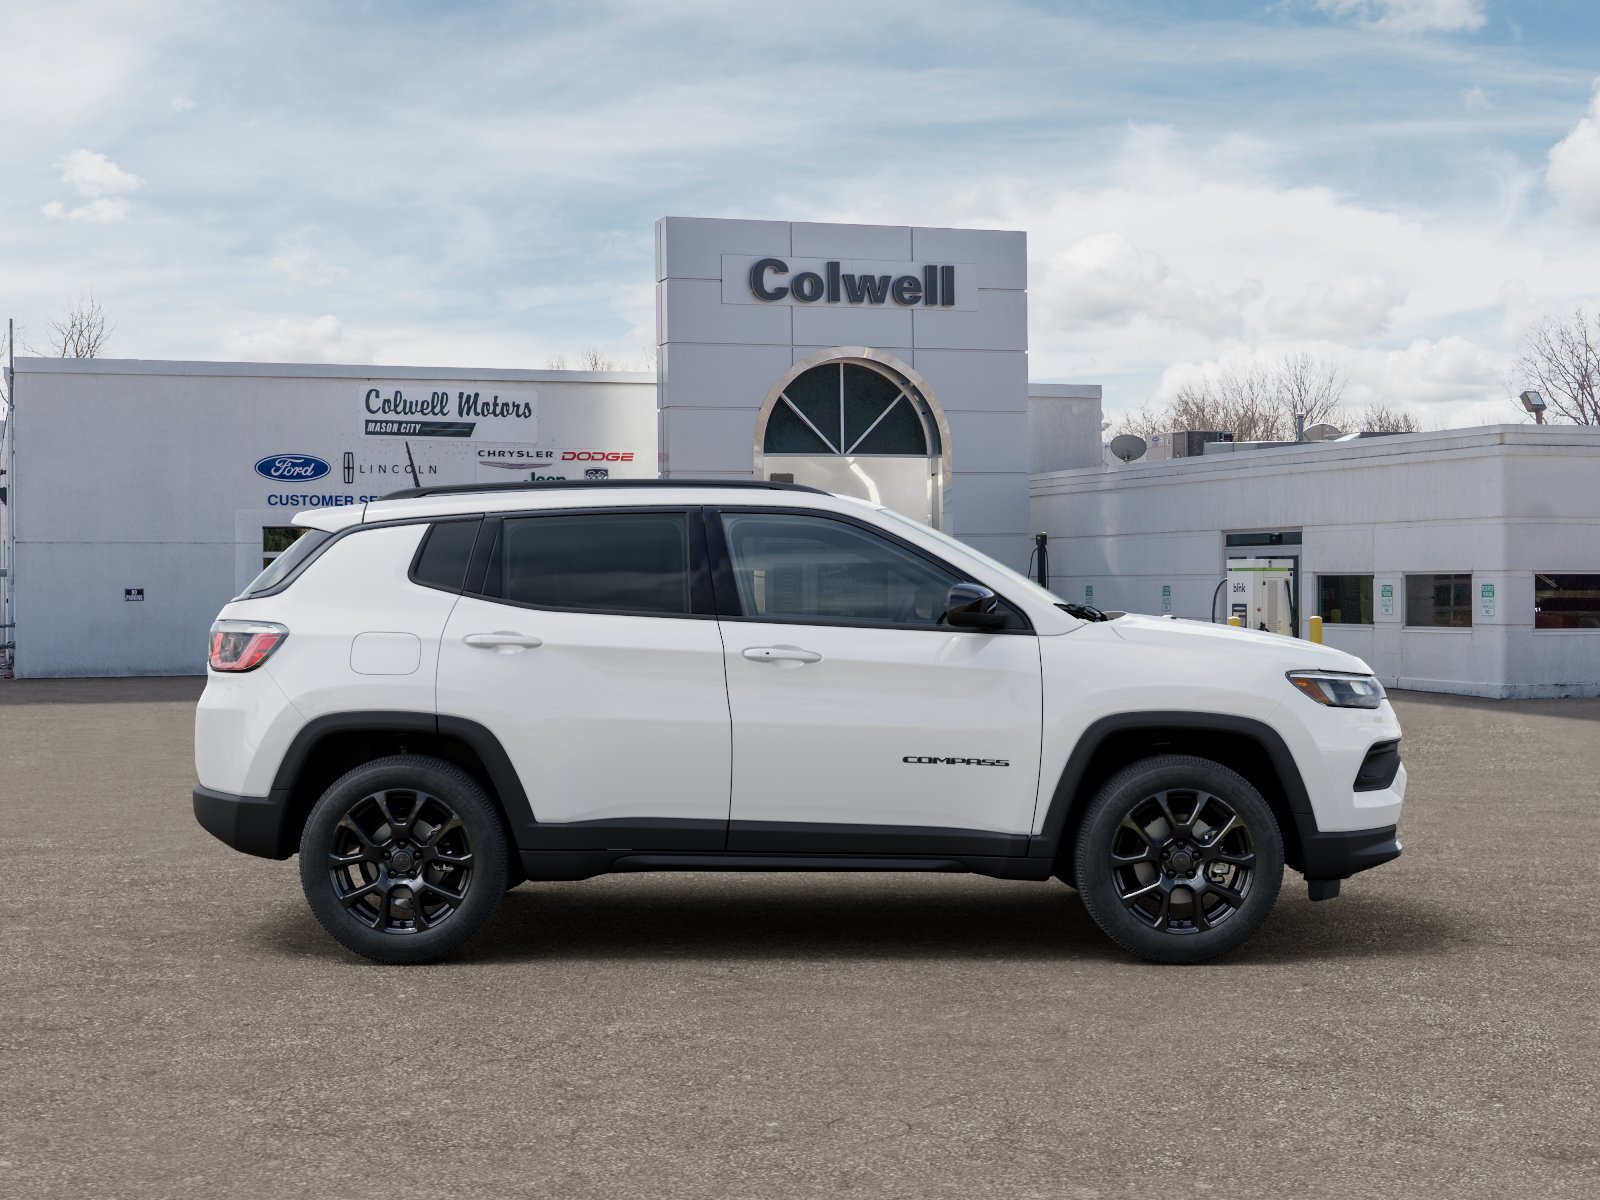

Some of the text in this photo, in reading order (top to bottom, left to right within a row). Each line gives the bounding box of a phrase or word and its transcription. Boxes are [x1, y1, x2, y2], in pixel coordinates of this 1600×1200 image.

[750, 258, 955, 306] Colwell
[364, 388, 532, 419] Colwell Motors
[366, 421, 422, 434] MASON CITY
[477, 449, 553, 459] CHRYSLER
[561, 451, 635, 462] DODGE
[270, 457, 315, 477] Ford
[359, 464, 437, 475] LINCOLN
[267, 494, 354, 507] CUSTOMER
[902, 756, 1010, 766] COMPASS
